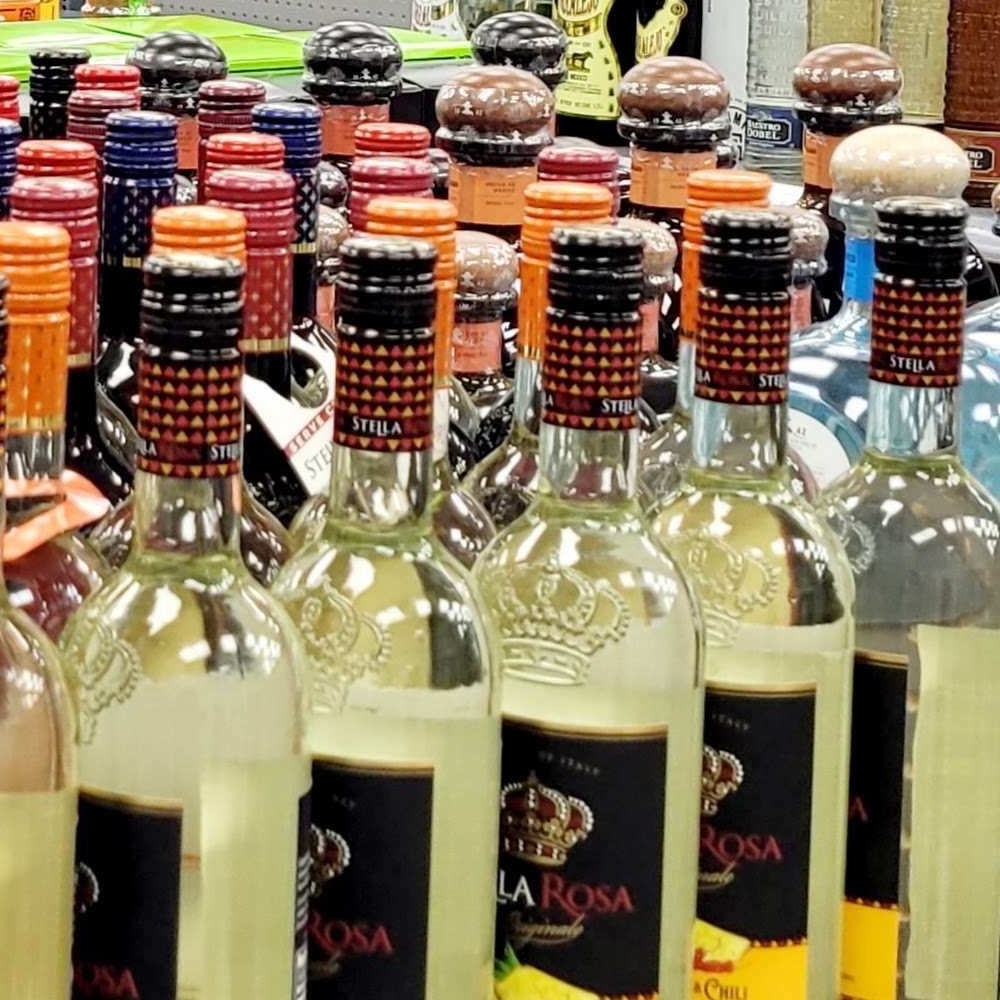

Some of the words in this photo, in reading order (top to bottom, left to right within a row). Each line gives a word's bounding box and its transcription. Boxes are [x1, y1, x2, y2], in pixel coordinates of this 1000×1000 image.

[747, 129, 780, 140] DOBEL
[890, 354, 935, 373] STELLA
[288, 414, 325, 451] SERVE
[353, 416, 401, 438] STELLA
[561, 757, 600, 776] ITALY
[541, 872, 633, 920] ROSA
